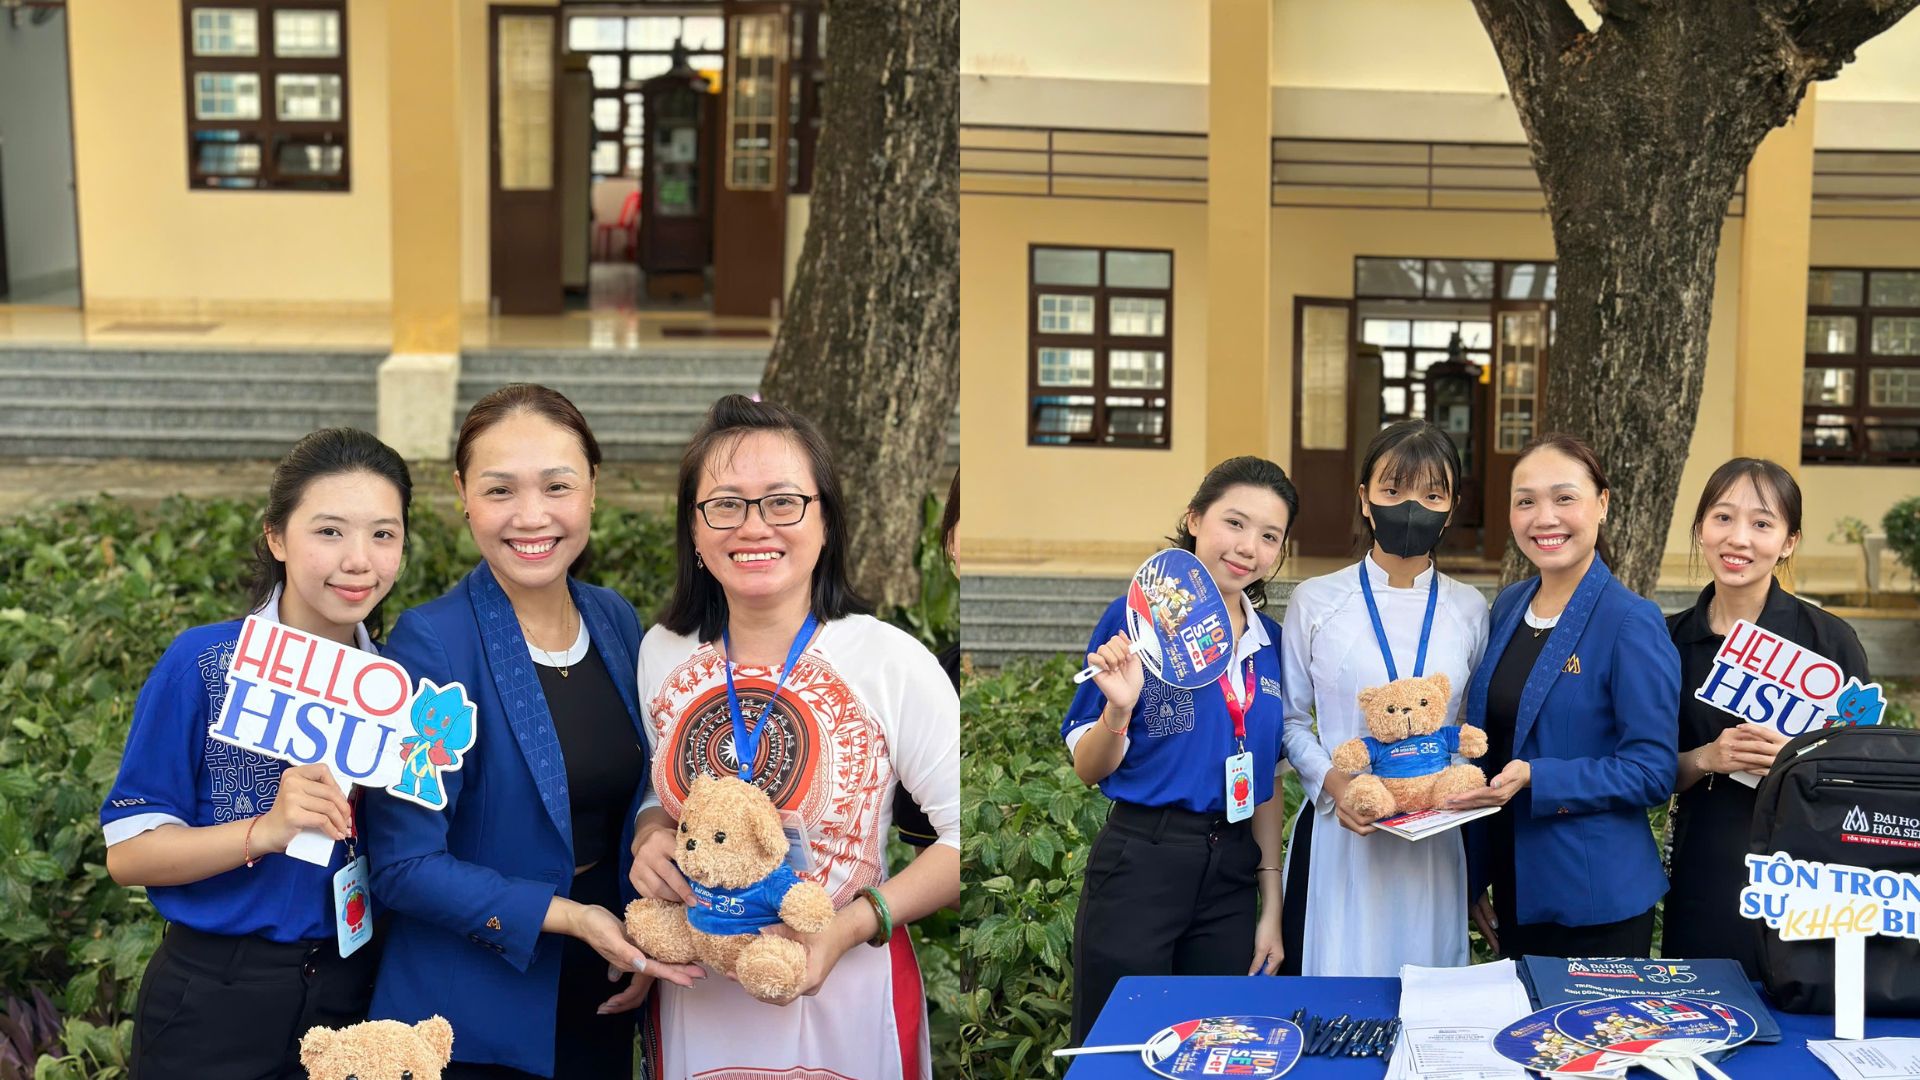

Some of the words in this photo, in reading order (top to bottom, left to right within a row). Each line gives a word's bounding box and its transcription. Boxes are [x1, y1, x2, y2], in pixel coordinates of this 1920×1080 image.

[1193, 624, 1220, 664] SEN
[1203, 614, 1229, 655] HOA
[234, 619, 408, 716] HELLO
[1720, 623, 1841, 700] HELLO
[1698, 660, 1825, 737] HSU
[214, 675, 396, 778] HSU
[1420, 742, 1439, 754] 35
[210, 766, 255, 793] HSU
[111, 798, 146, 807] HSU
[1872, 824, 1902, 837] HOA
[1903, 828, 1920, 839] SE
[1873, 812, 1898, 825] ĐẠI
[1749, 857, 1819, 890] TÔN
[715, 895, 745, 915] 35
[1744, 891, 1790, 925] SỰ
[1784, 899, 1878, 937] KHÁC
[1883, 908, 1916, 935] BI
[1643, 964, 1698, 984] 35
[1223, 1049, 1256, 1075] SEN
[1250, 1050, 1278, 1074] HOA
